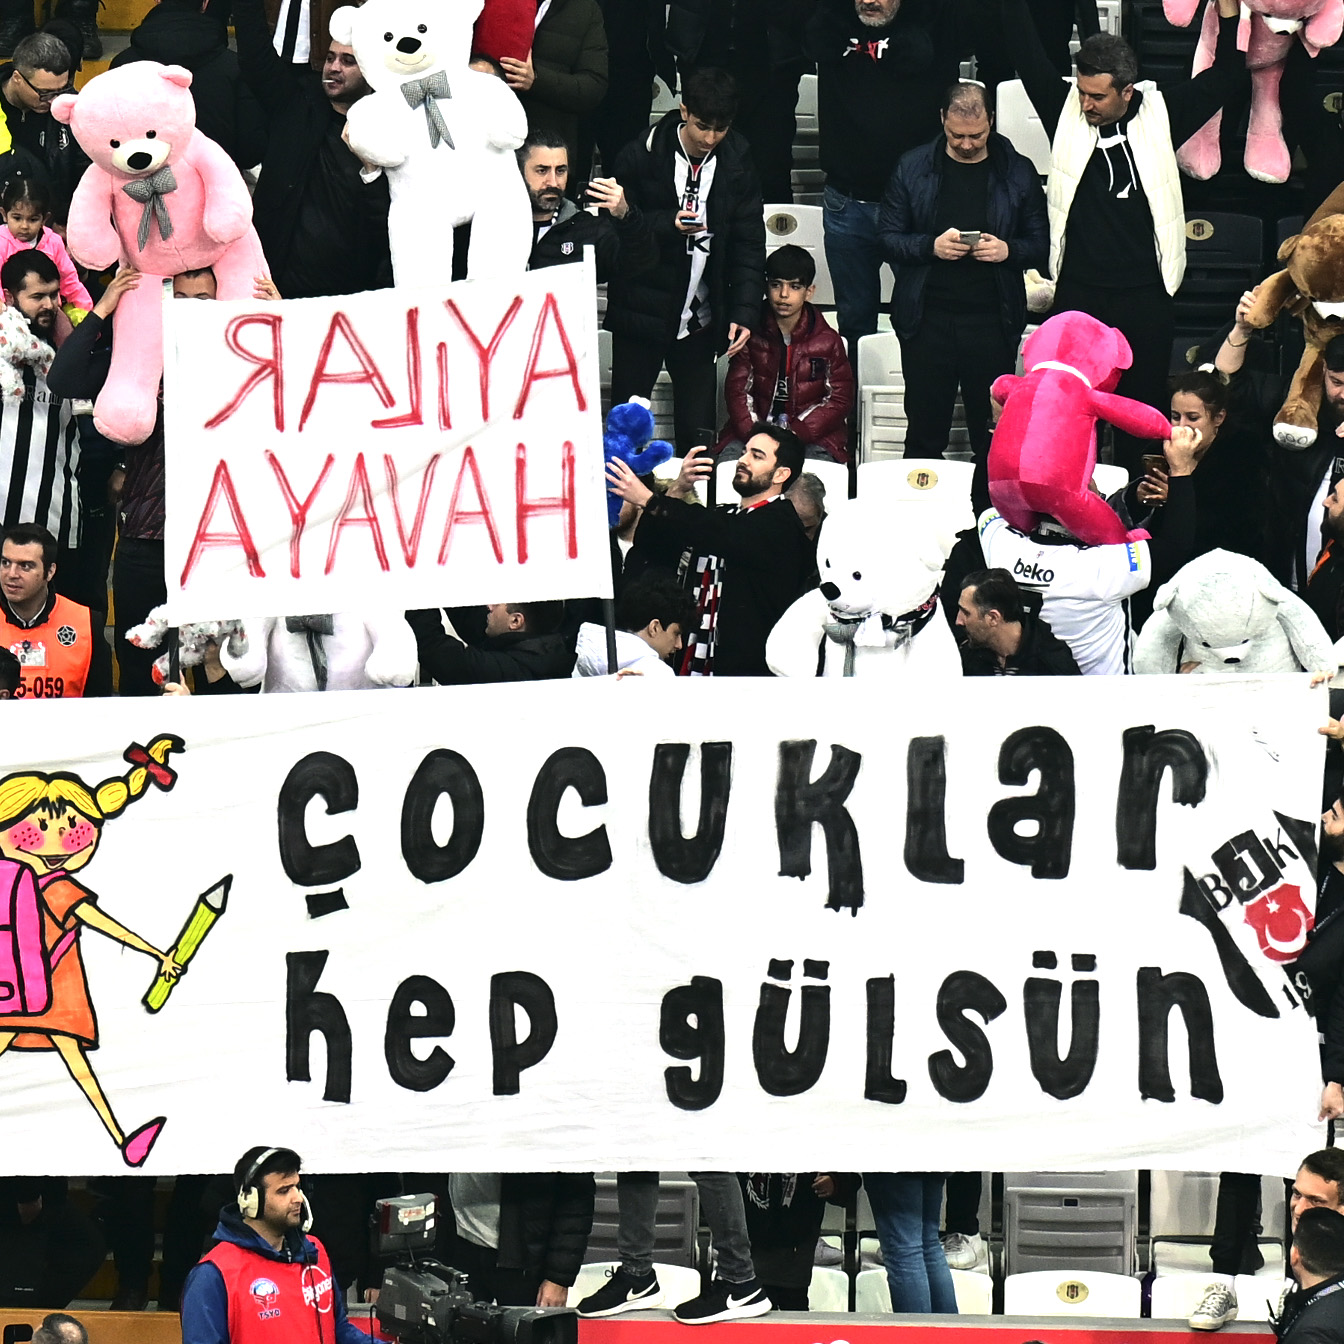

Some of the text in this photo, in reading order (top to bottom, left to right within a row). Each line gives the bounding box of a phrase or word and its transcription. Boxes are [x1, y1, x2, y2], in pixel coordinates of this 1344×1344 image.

[1013, 558, 1055, 584] beko
[1197, 826, 1300, 914] BJK
[1281, 970, 1313, 1010] 19
[285, 949, 1225, 1111] hep gülsün
